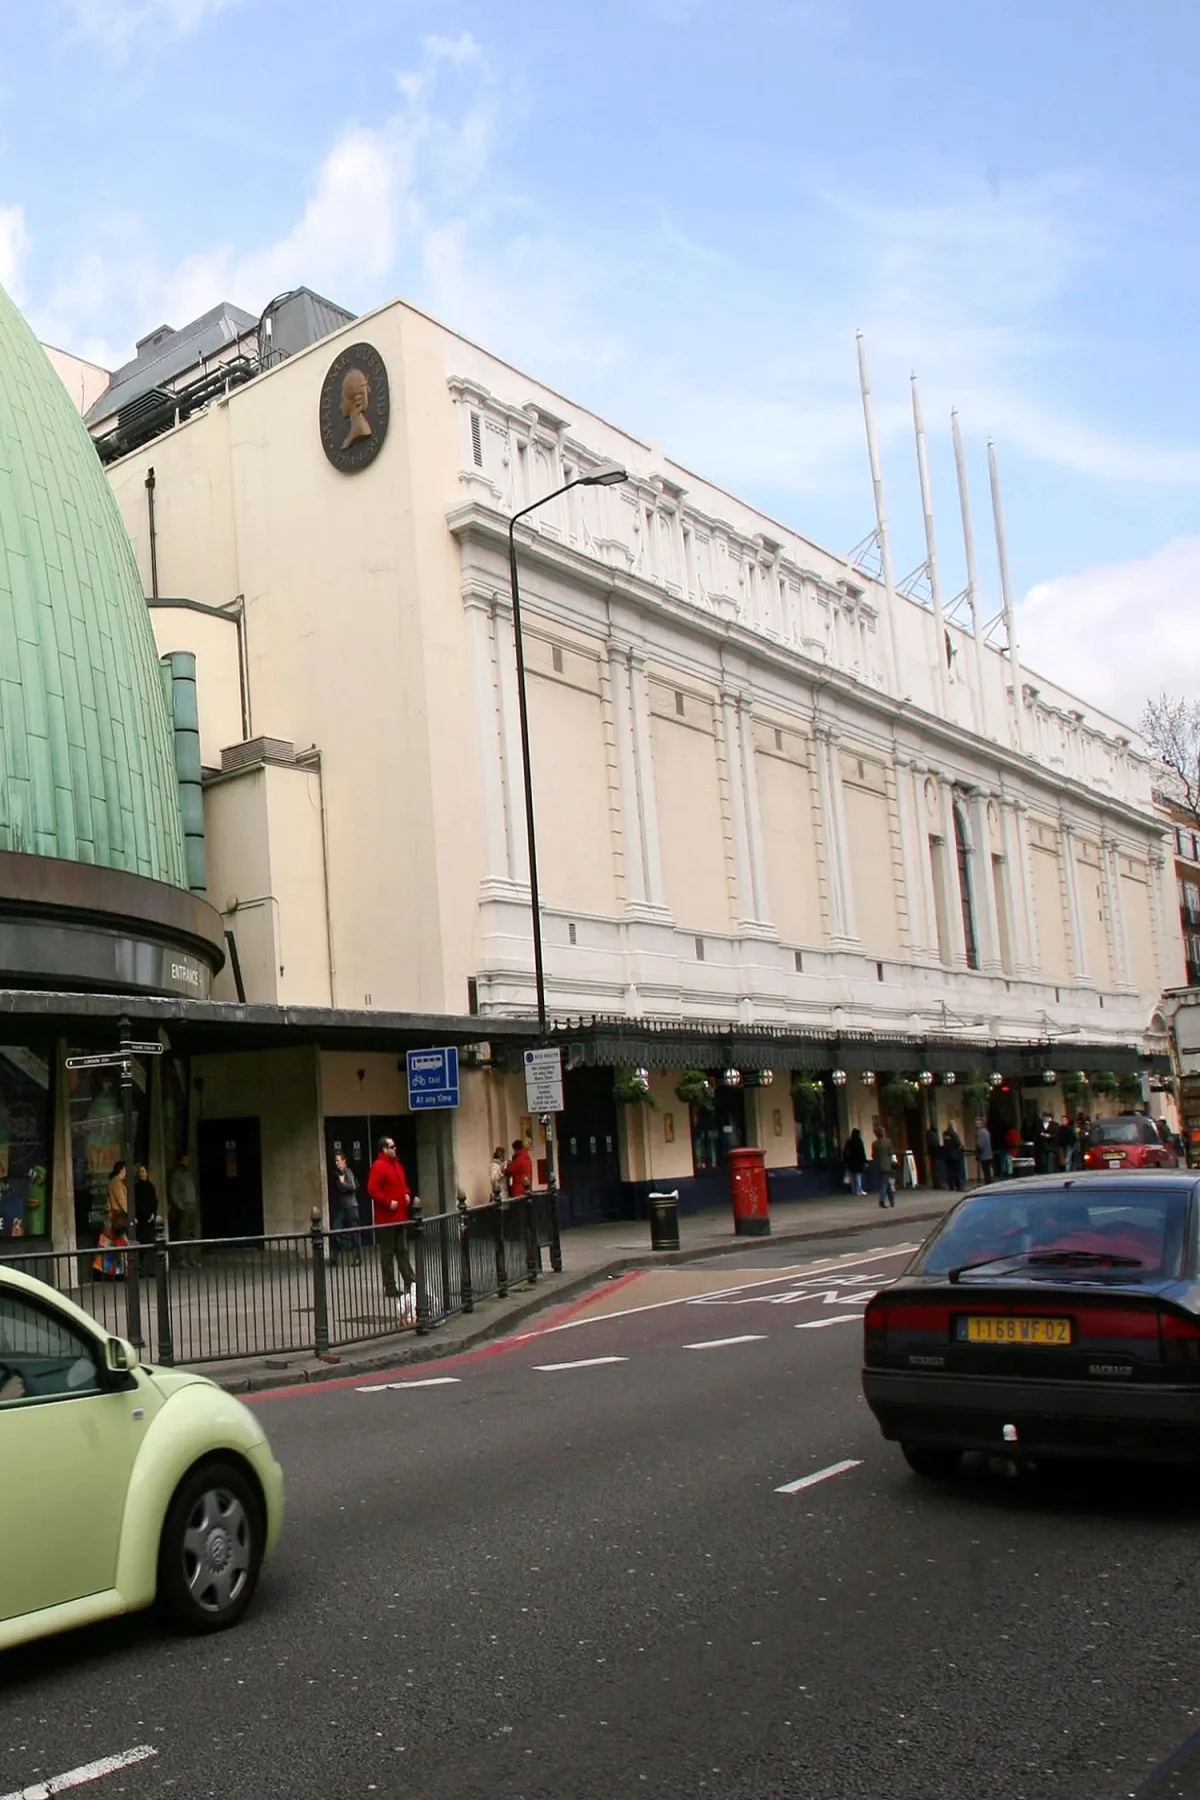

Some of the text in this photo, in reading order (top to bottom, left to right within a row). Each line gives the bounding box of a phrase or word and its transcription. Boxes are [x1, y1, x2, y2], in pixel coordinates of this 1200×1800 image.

[171, 963, 199, 987] ENTRANCE
[428, 1075, 441, 1084] taxi
[416, 1094, 452, 1105] At any time
[686, 1290, 879, 1304] LANE
